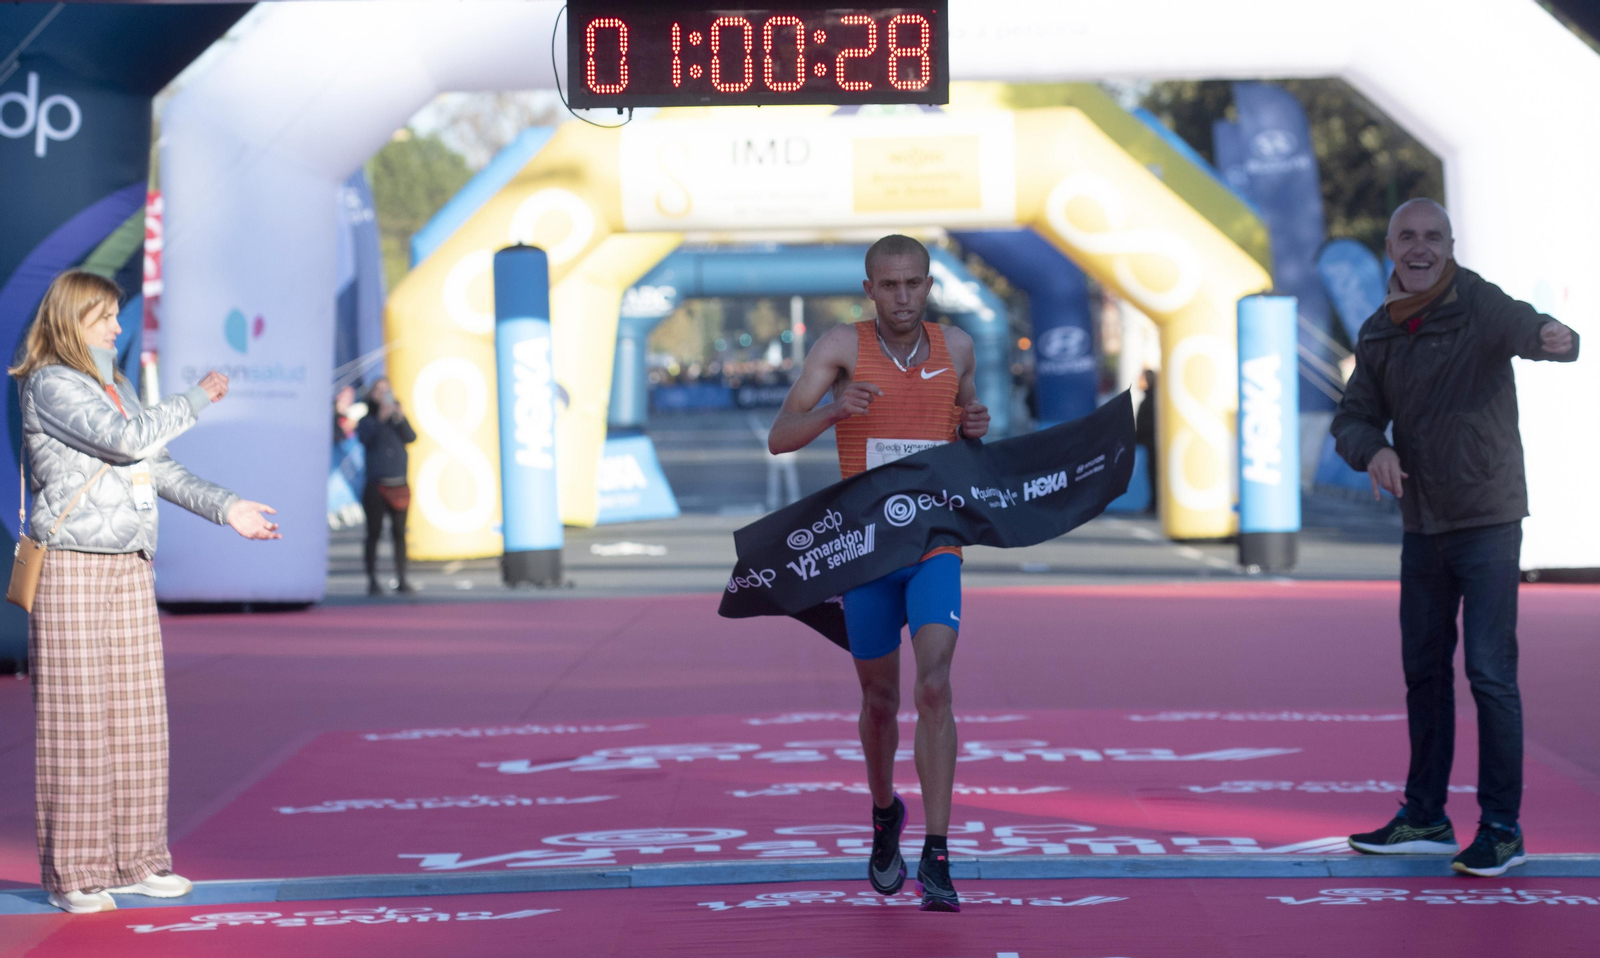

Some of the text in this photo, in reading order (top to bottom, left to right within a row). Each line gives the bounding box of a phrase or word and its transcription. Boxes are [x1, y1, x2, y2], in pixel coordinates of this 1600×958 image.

[732, 136, 811, 167] IMD
[512, 336, 554, 471] HOKA
[1241, 353, 1282, 485] HOKA
[917, 489, 965, 511] edp
[1023, 470, 1068, 502] HOKA
[811, 508, 843, 532] edp
[805, 530, 863, 561] maratón
[827, 542, 866, 570] sevilla
[735, 568, 777, 589] edp
